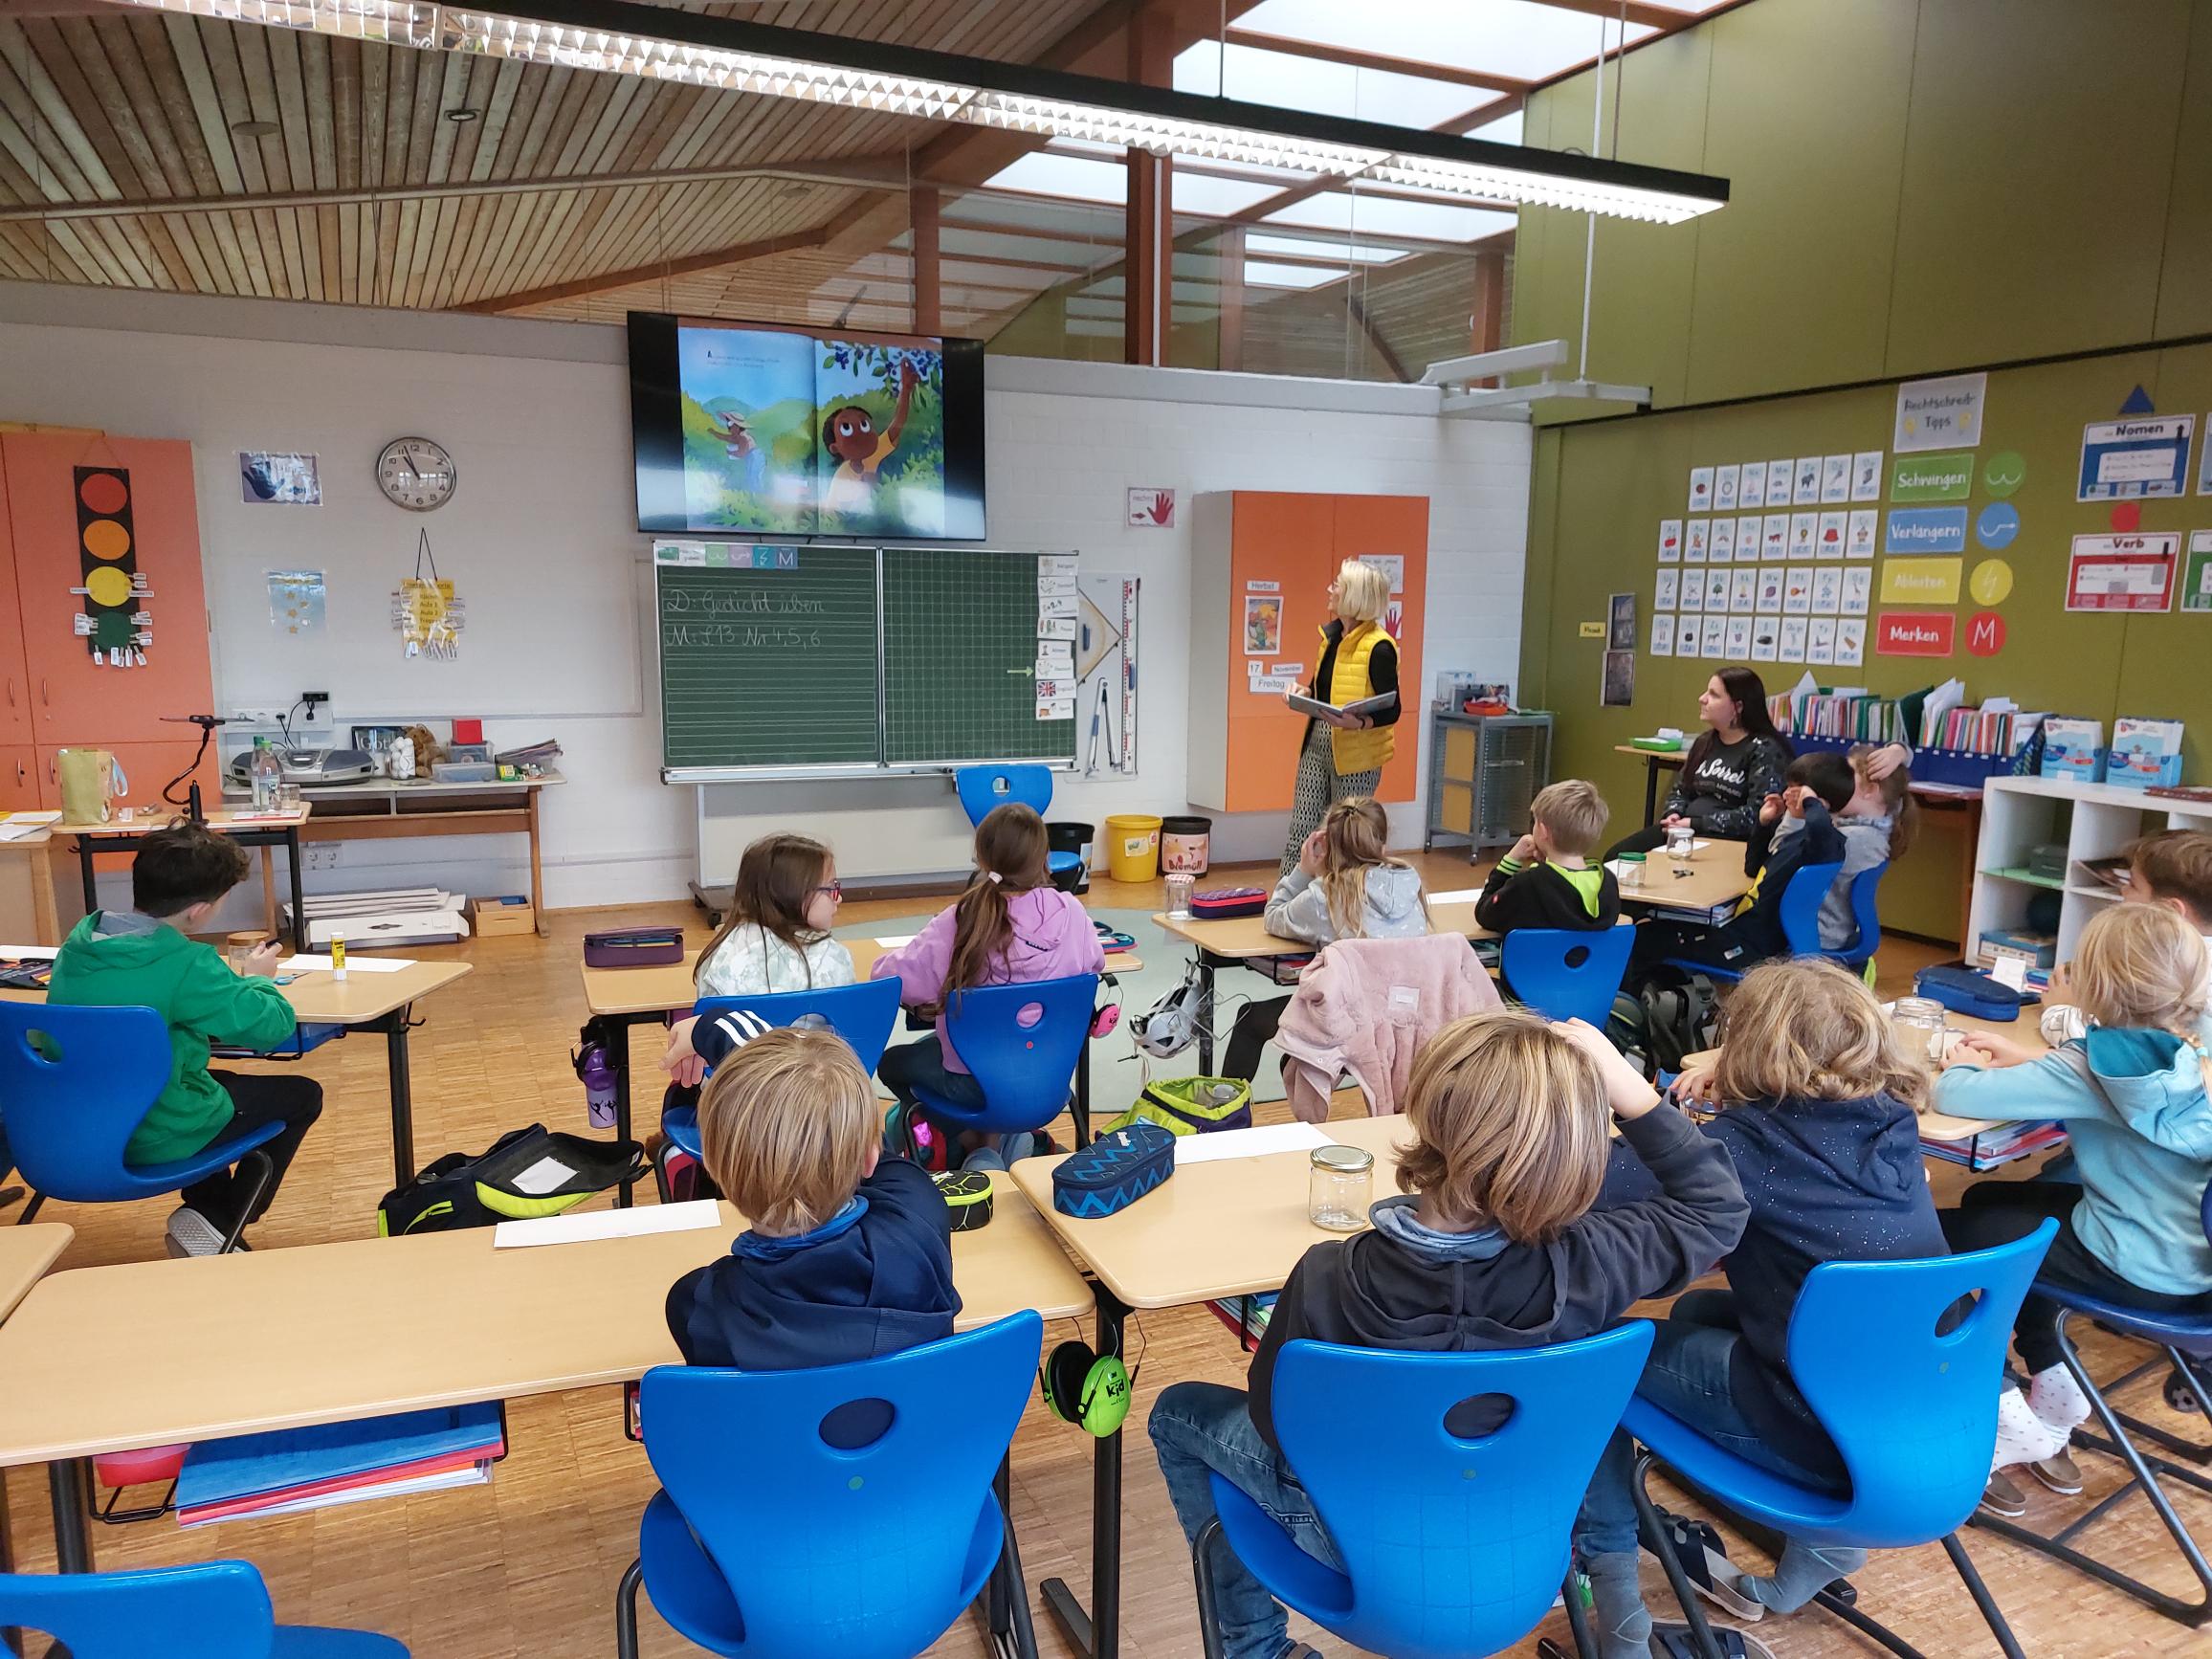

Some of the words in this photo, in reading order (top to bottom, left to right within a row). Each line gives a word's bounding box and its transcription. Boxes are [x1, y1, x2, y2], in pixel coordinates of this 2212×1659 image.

[1925, 415, 1952, 430] Tipps
[2115, 424, 2164, 436] Nomen
[1897, 473, 1966, 491] Schwingen
[2112, 537, 2145, 548] Verb
[779, 552, 793, 566] M
[702, 590, 772, 619] Gedicht
[779, 593, 825, 613] üben
[1890, 626, 1939, 643] Merken
[1973, 618, 1996, 649] M
[1257, 678, 1285, 689] Freitag
[1168, 859, 1203, 871] Biomüll
